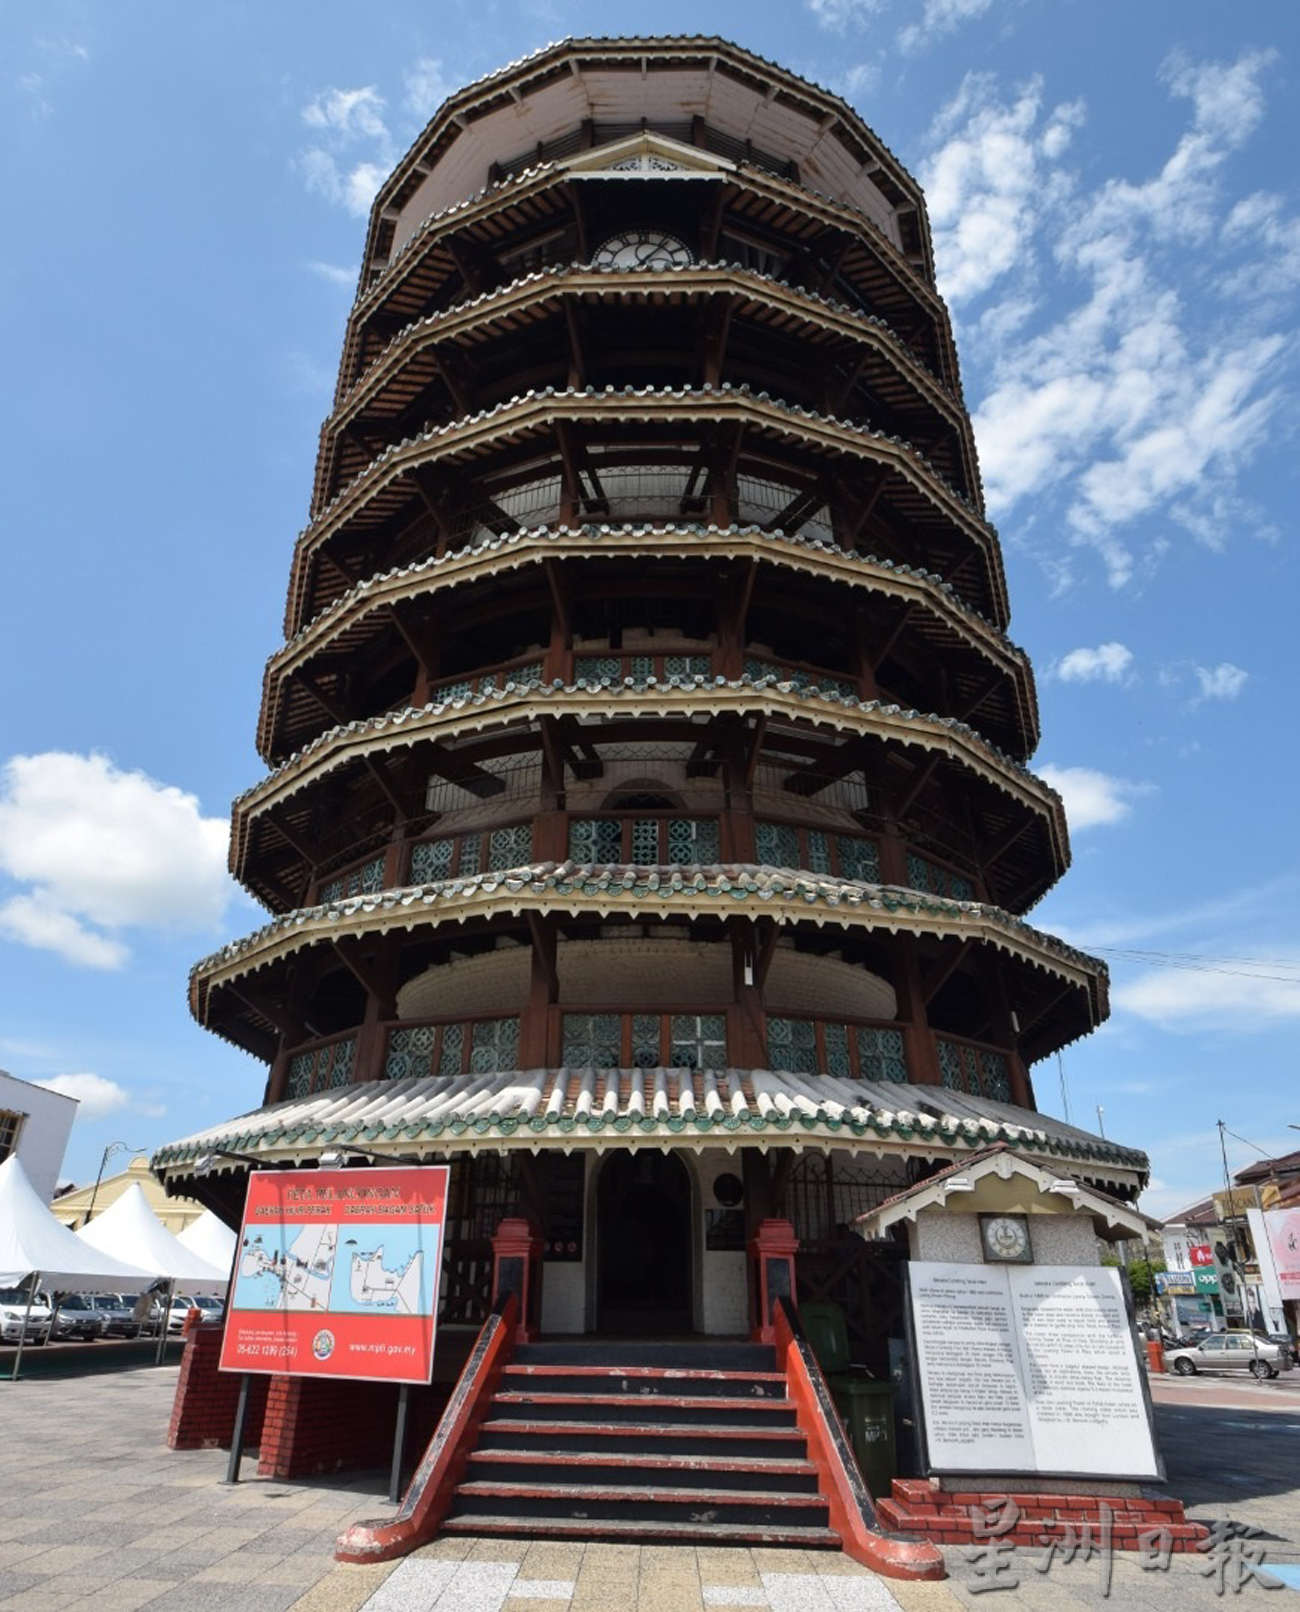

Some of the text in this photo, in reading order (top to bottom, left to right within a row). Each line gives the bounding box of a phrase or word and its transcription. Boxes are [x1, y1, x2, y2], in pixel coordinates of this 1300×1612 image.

[287, 1187, 312, 1201] PETA
[306, 1204, 332, 1216] PERAK
[344, 1204, 376, 1216] DAERAH
